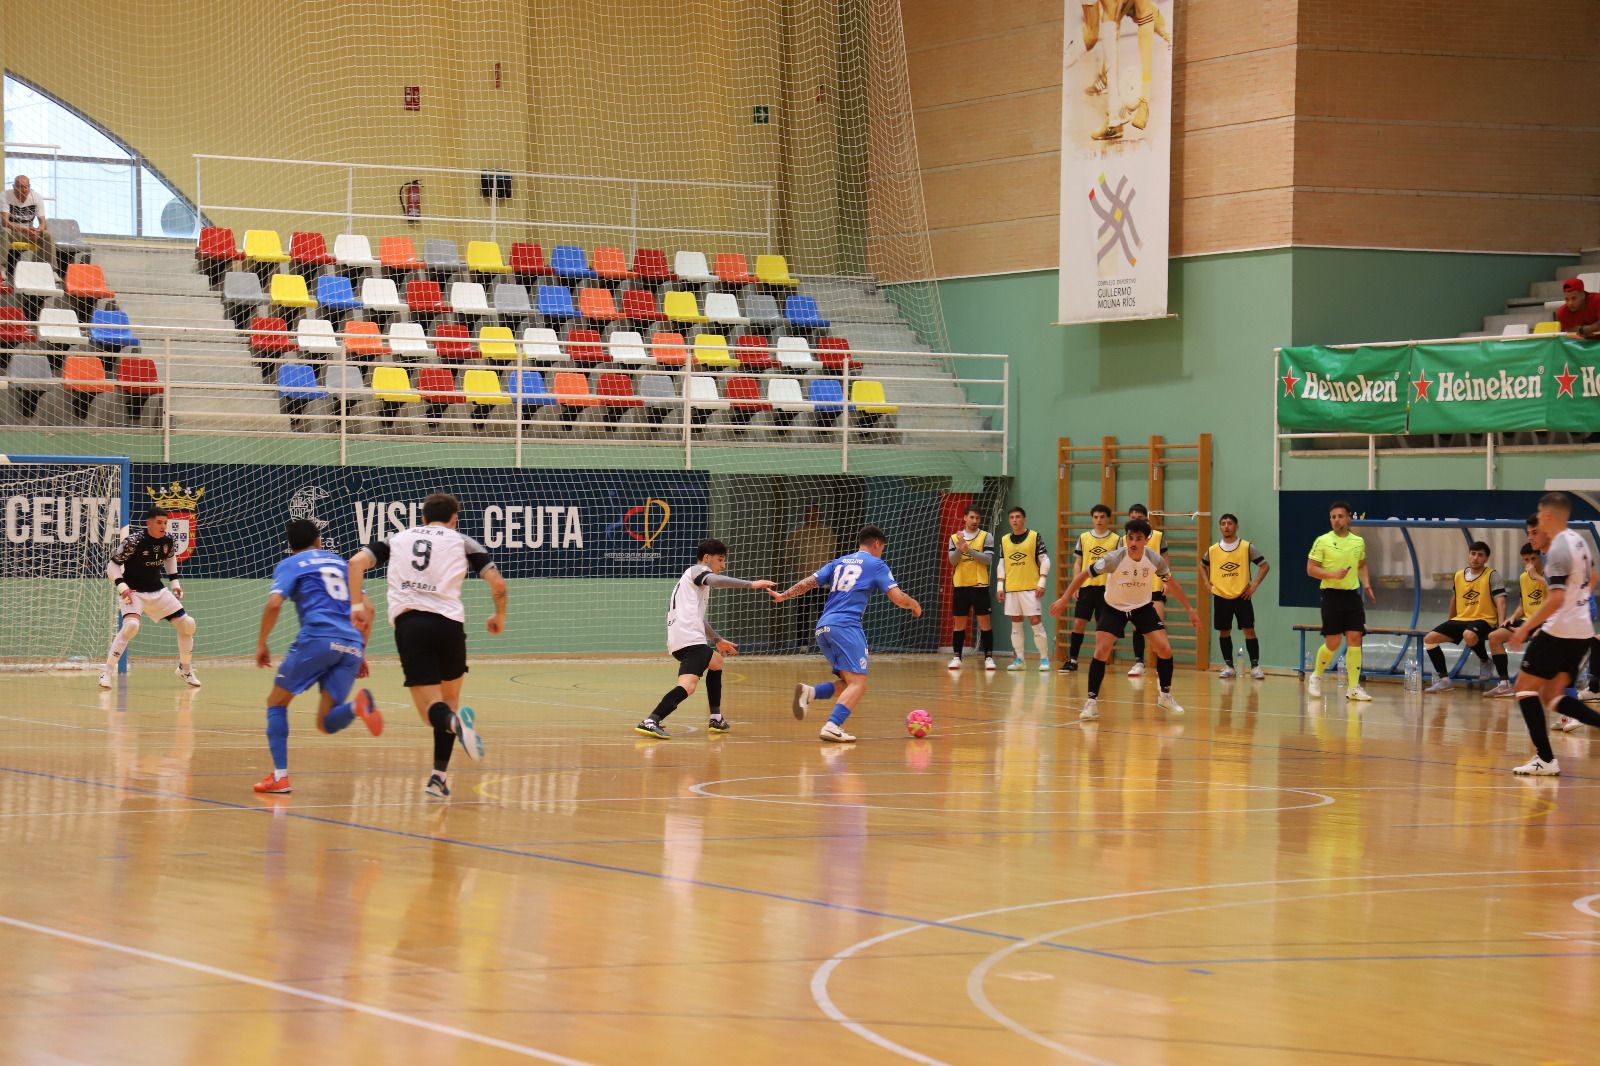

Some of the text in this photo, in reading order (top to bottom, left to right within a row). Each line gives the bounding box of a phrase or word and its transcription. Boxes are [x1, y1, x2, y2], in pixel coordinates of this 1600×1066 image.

[1097, 286, 1132, 299] GUILLERMO
[1097, 296, 1136, 309] MOLINA RÍOS
[5, 496, 121, 544] CEUTA
[354, 501, 583, 549] VISI CEUTA
[411, 539, 433, 572] 9
[319, 566, 349, 601] 6
[831, 564, 863, 592] 18
